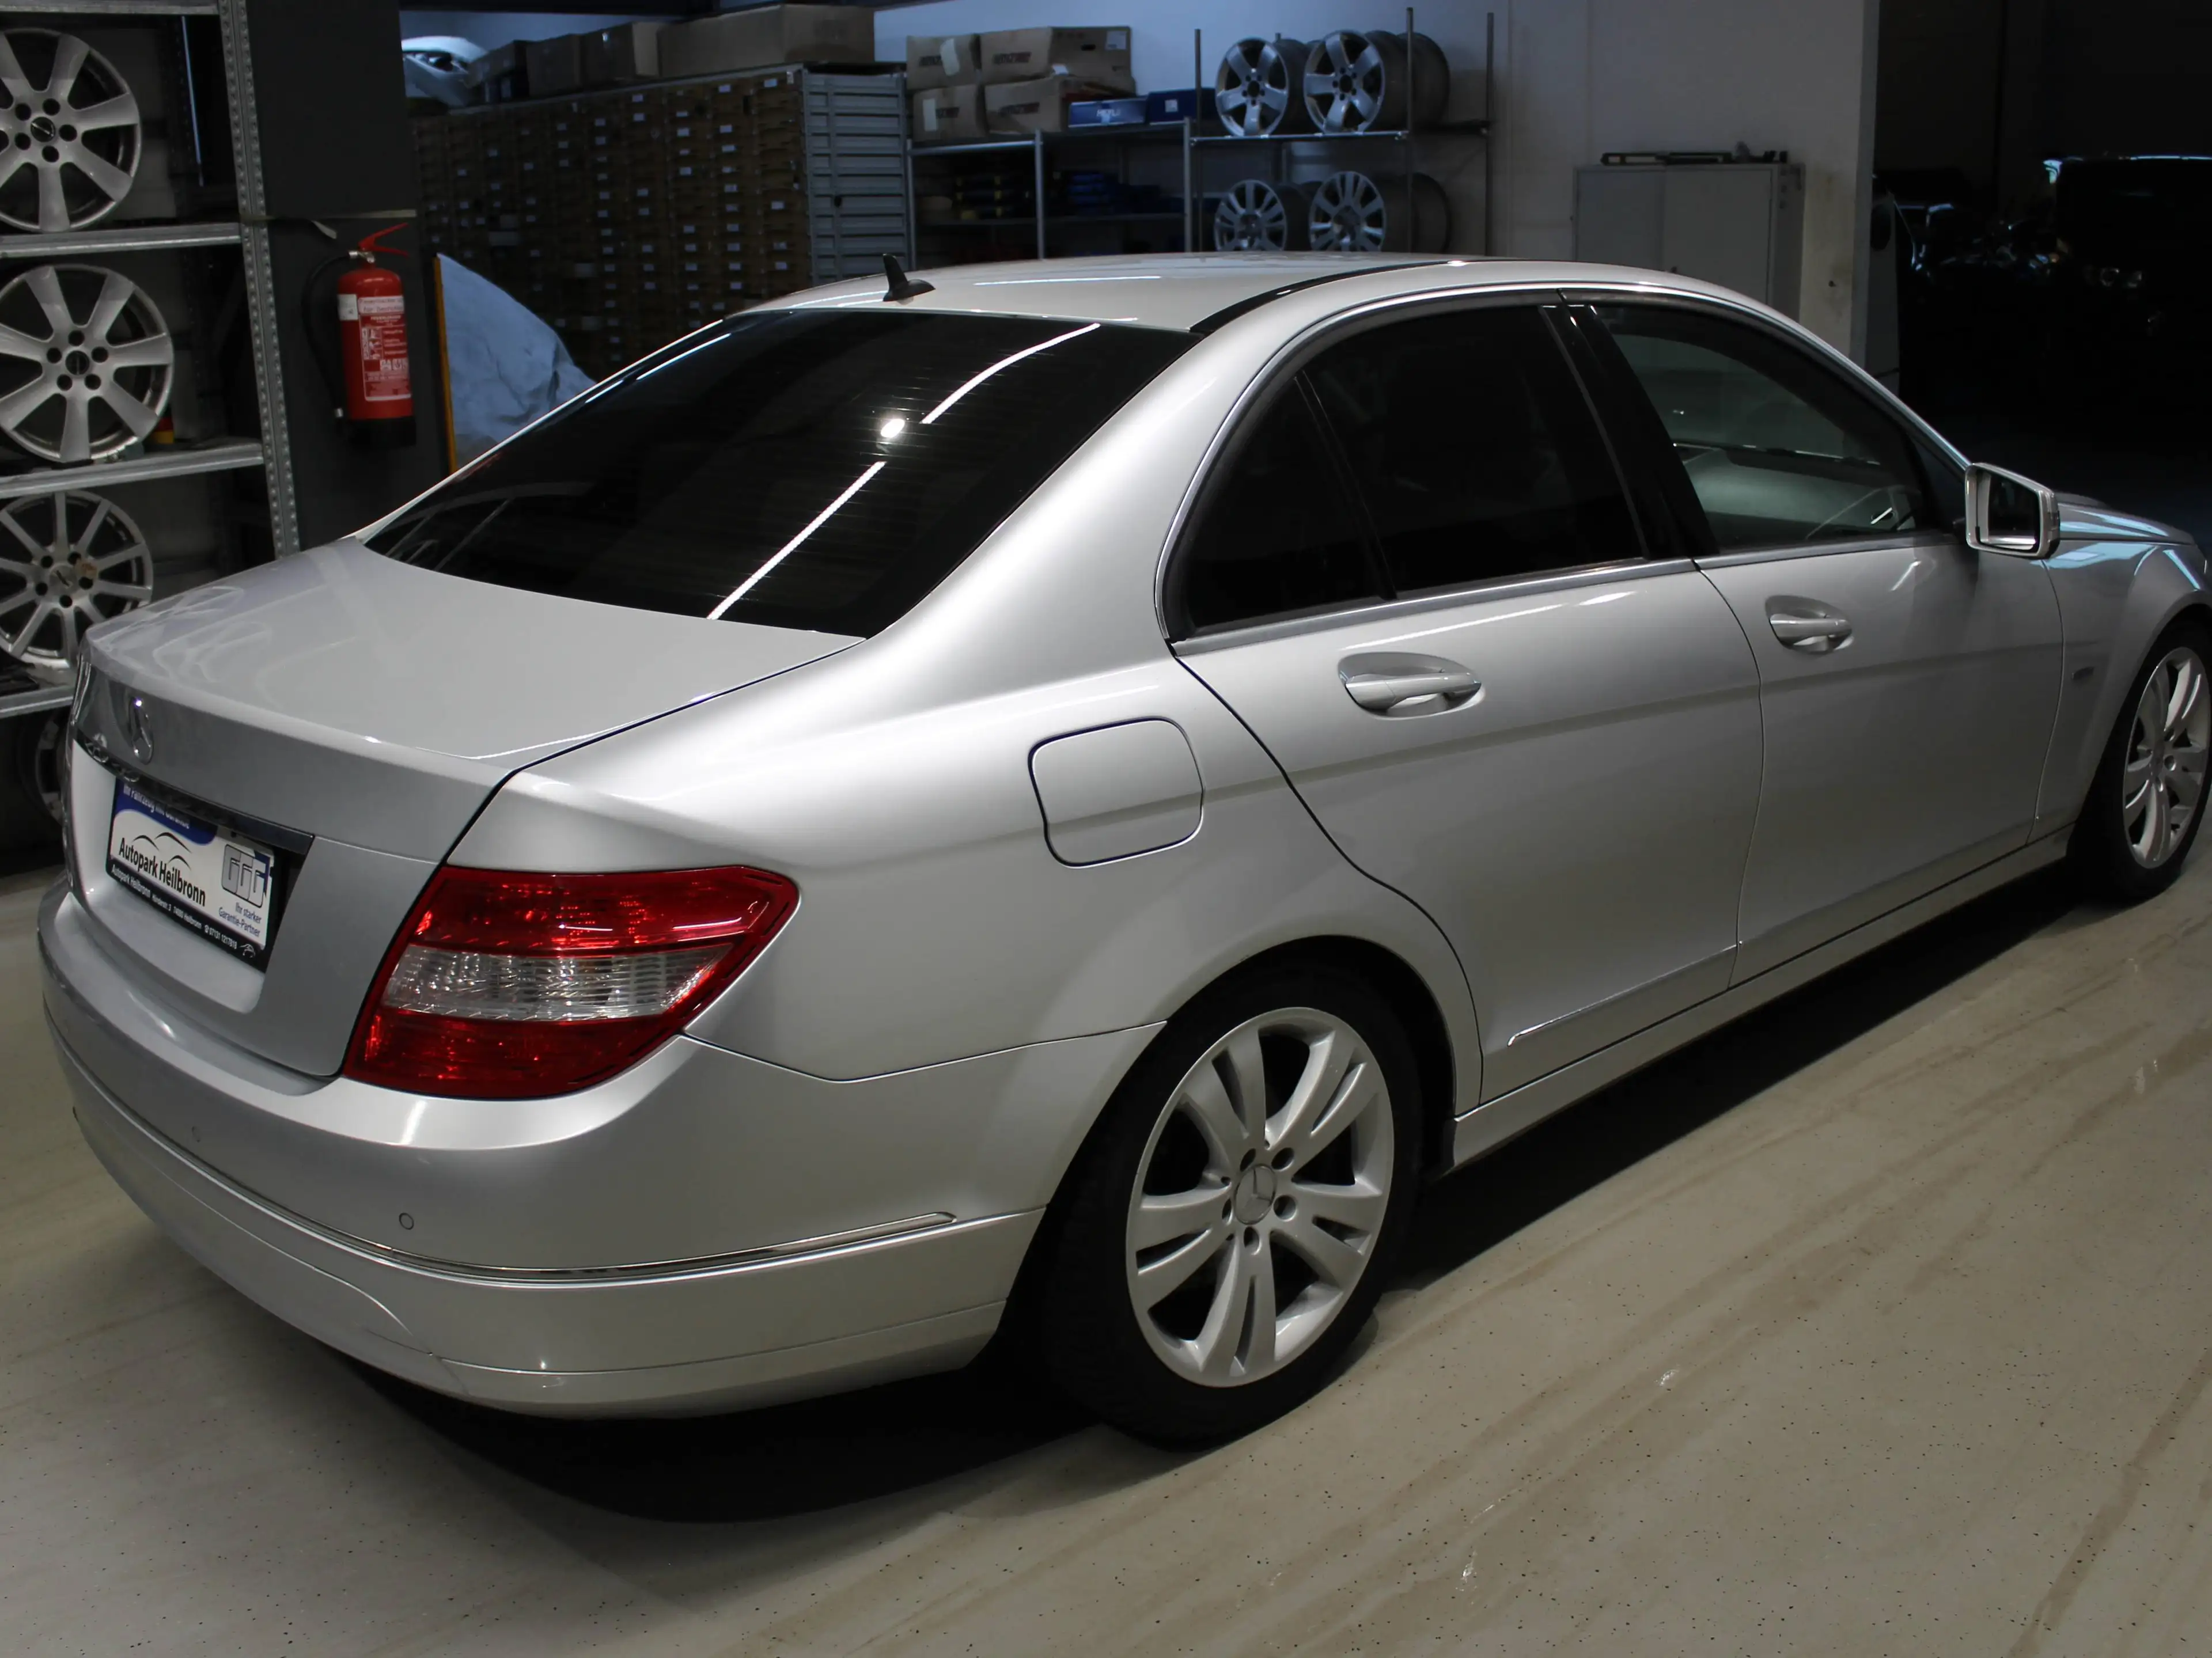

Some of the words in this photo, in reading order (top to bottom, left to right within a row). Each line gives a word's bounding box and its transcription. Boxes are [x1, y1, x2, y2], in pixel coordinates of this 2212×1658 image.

[119, 837, 158, 879] Autopark
[159, 861, 206, 907] Heilbronn
[218, 906, 261, 938] Garantie-Partner
[243, 908, 262, 924] starker
